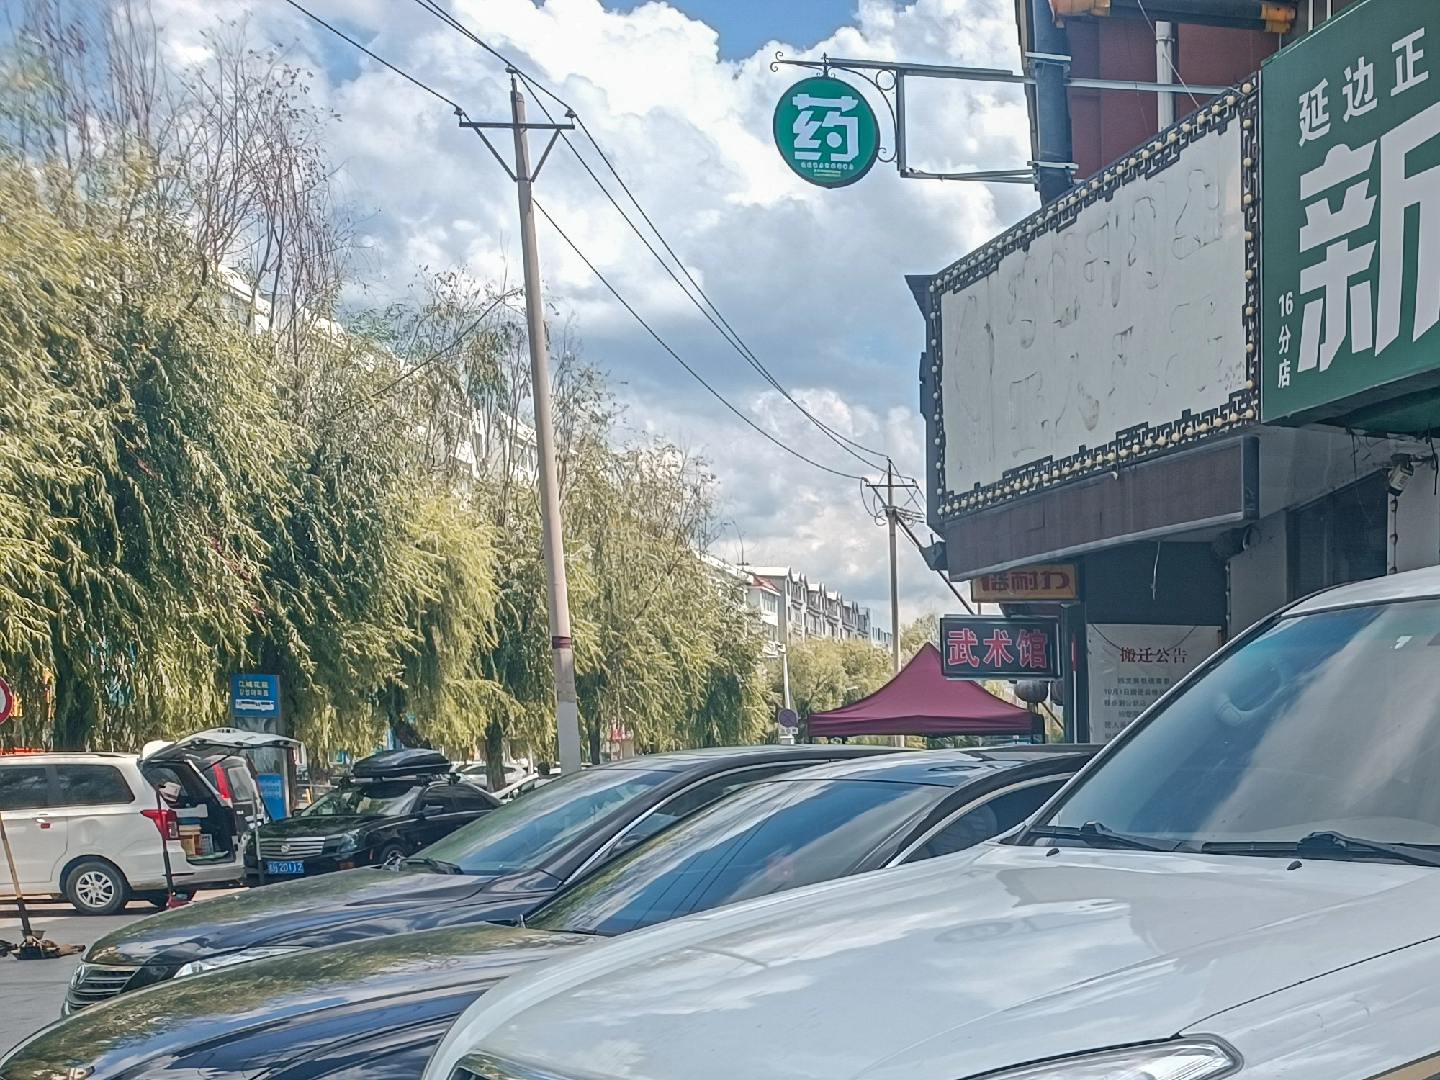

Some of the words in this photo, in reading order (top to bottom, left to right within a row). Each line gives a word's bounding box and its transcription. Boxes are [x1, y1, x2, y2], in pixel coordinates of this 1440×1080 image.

[792, 93, 859, 162] 药
[947, 628, 1048, 669] 武术馆
[1120, 647, 1188, 663] 搬迁公告
